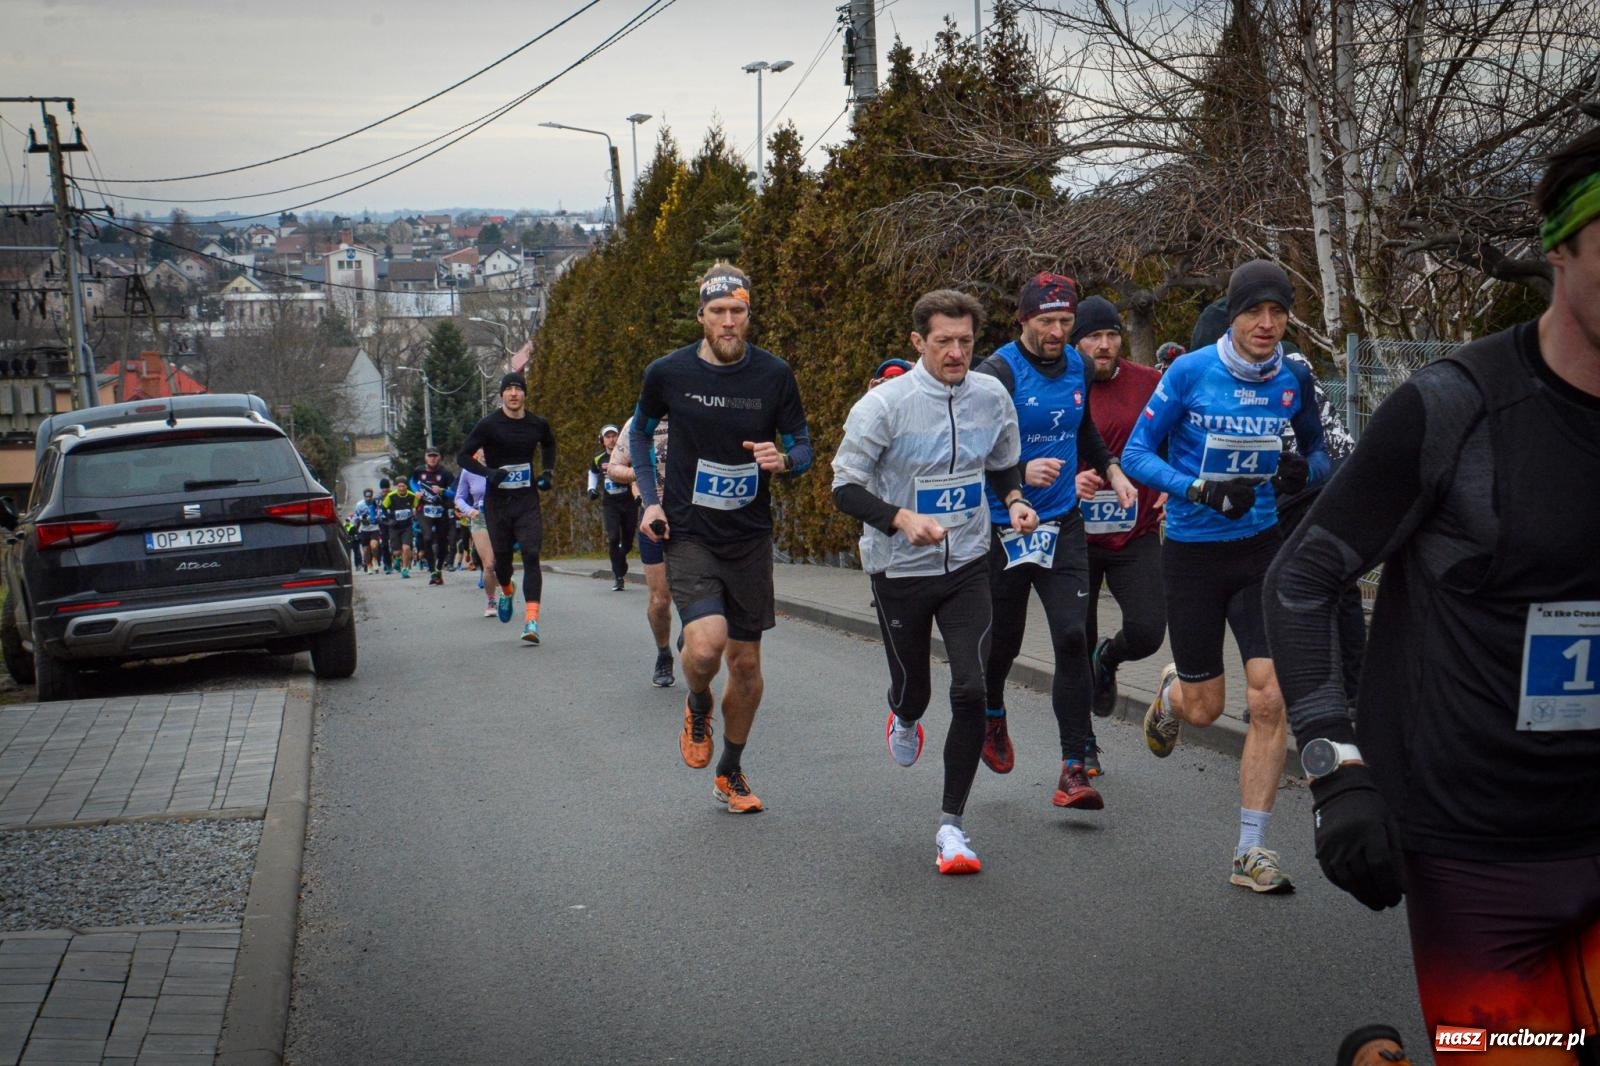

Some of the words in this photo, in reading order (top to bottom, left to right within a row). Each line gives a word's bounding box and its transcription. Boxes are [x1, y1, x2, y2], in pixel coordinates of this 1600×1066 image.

[707, 283, 729, 295] 2024
[1225, 451, 1260, 473] 14
[508, 471, 523, 482] 93
[708, 476, 748, 497] 126
[936, 487, 967, 512] 42
[1090, 503, 1128, 521] 194
[157, 532, 179, 549] OP
[186, 527, 237, 546] 1239P
[1016, 532, 1052, 557] 148
[175, 561, 222, 572] Ateca
[1562, 639, 1595, 691] 1
